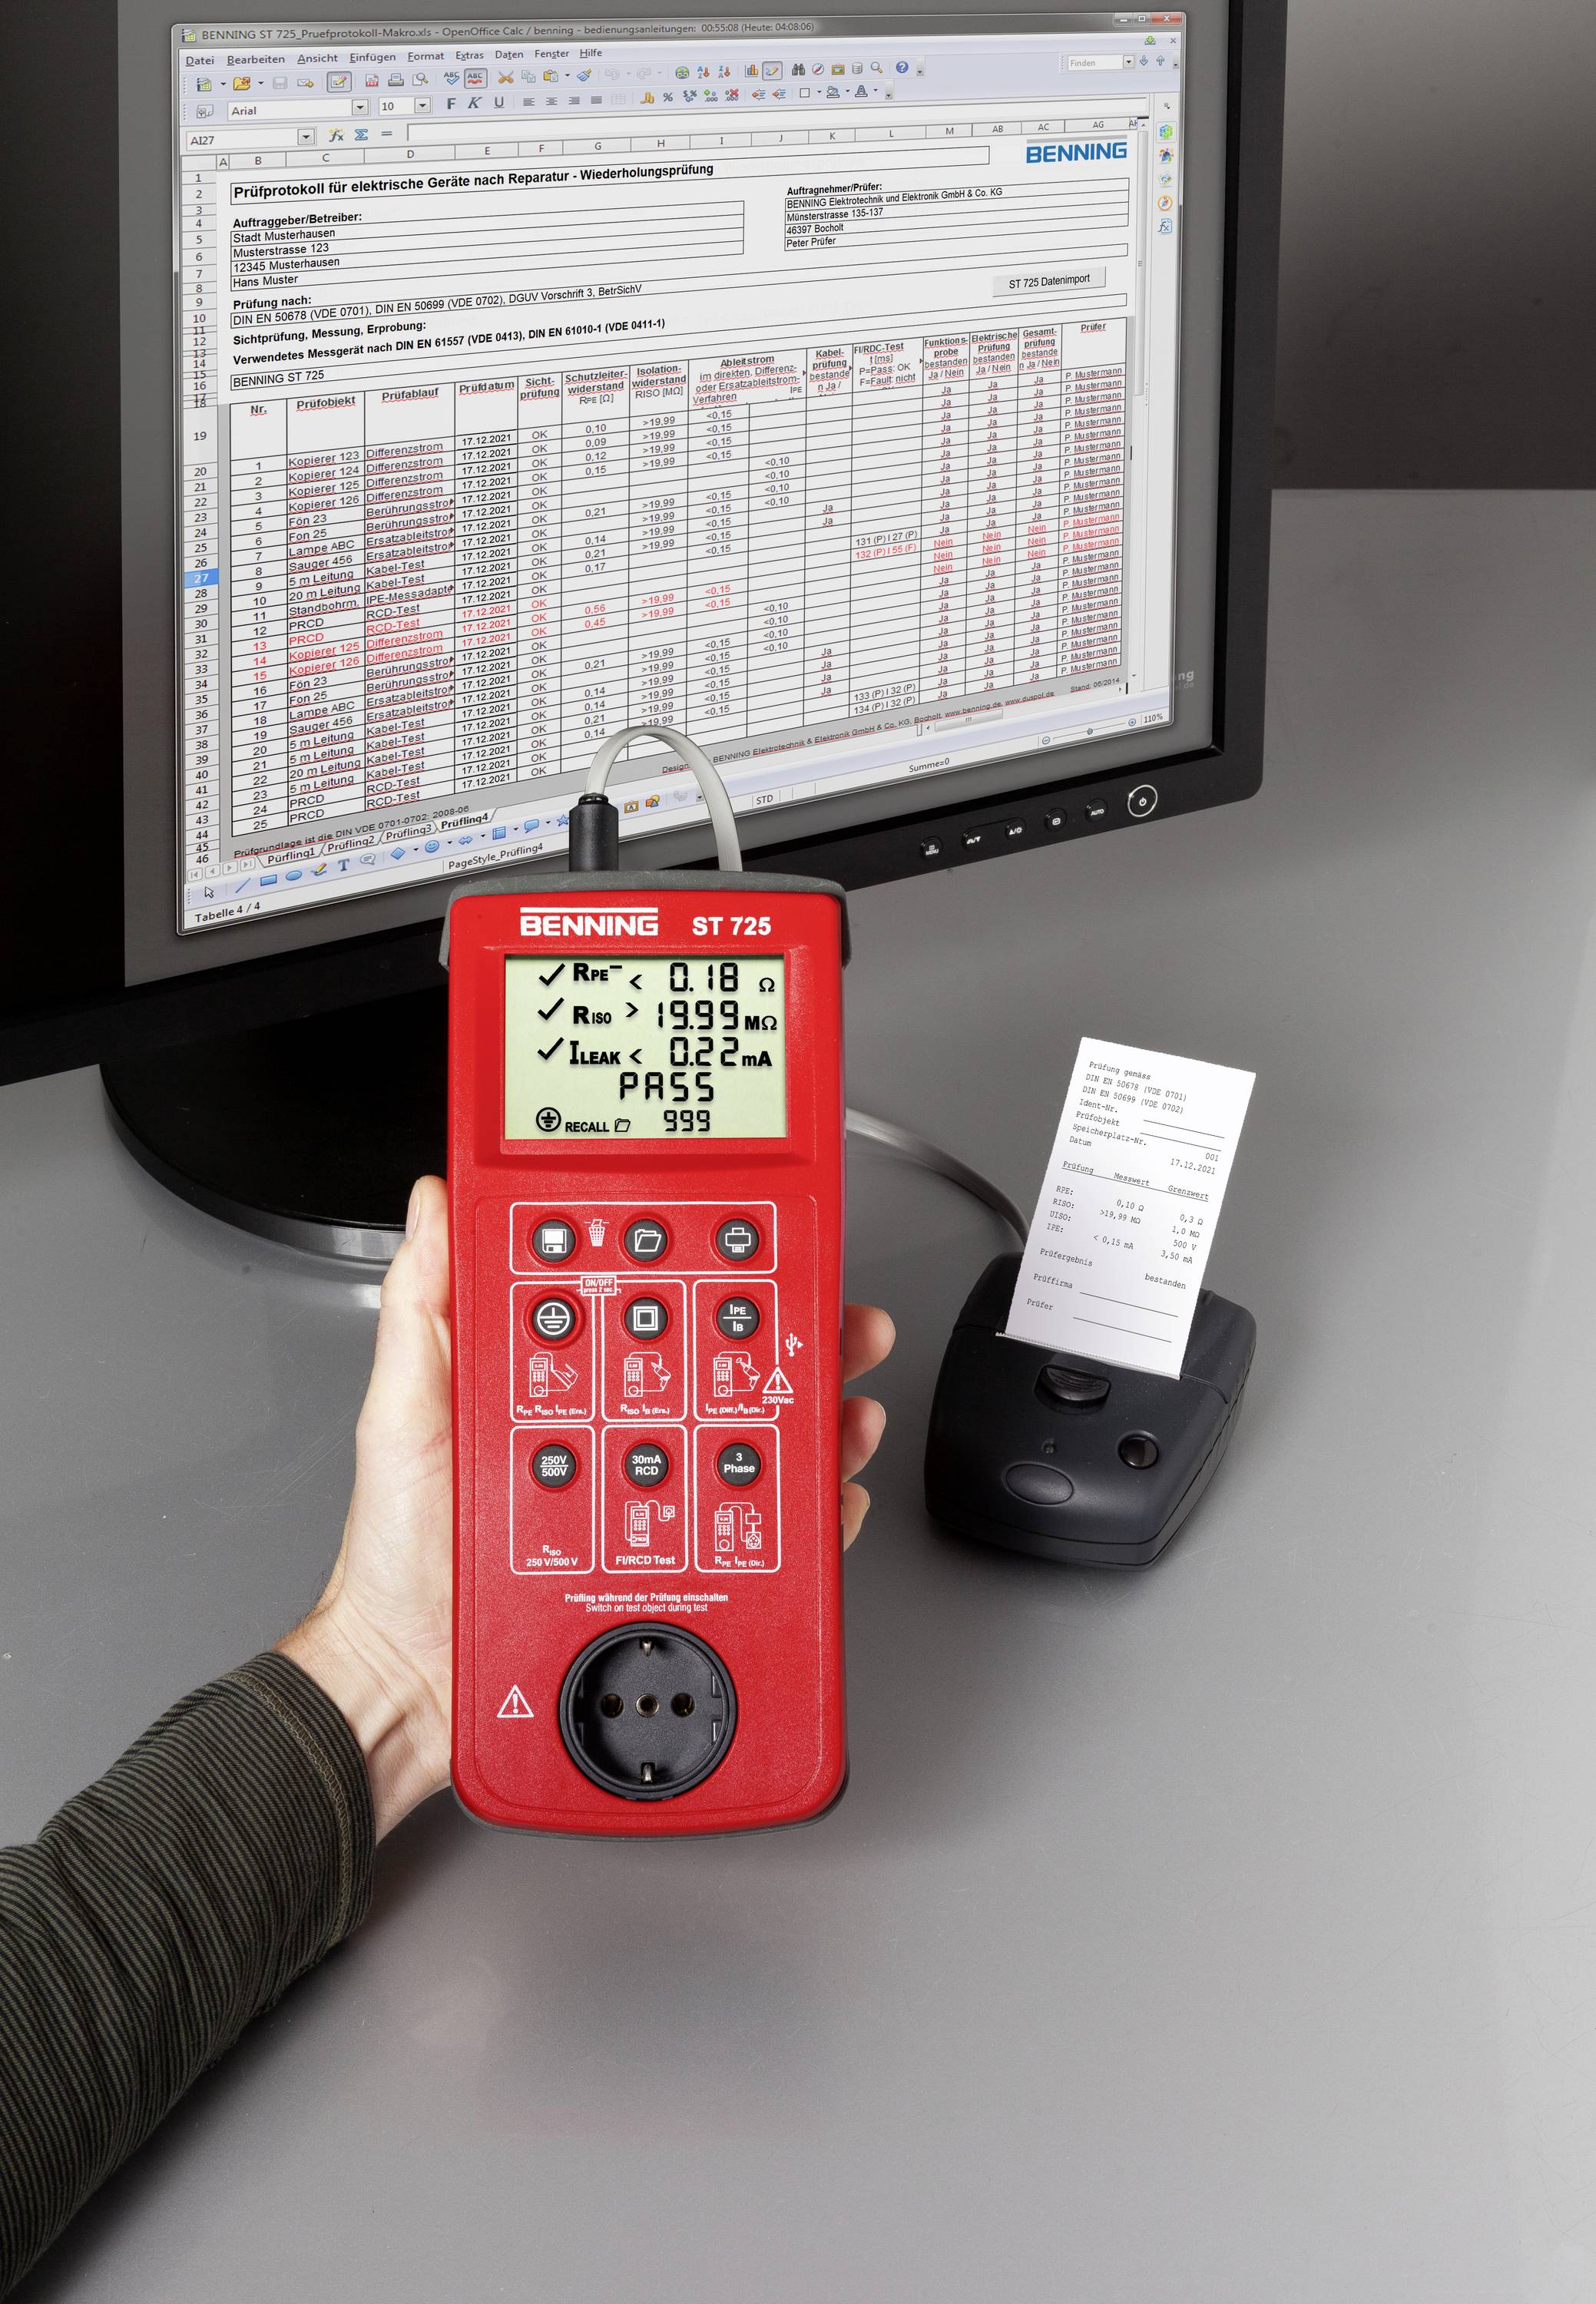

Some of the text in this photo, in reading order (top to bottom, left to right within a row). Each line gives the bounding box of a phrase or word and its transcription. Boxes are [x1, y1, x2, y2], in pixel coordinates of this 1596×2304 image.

[202, 31, 256, 39] BENNING
[442, 27, 499, 37] OpenOffice
[503, 27, 524, 35] Calc
[534, 26, 574, 36] benning
[584, 25, 696, 35] bedienungsanleitungen:
[701, 24, 739, 32] 00:55:08
[742, 23, 773, 31] (Heute:
[776, 22, 814, 31] 04:08:06)
[186, 48, 602, 67] Datei Bearbeiten Ansicht Einfügen Format Extras Daten Fenster Hilfe
[232, 106, 257, 115] Arial
[190, 136, 214, 145] AI27
[1026, 142, 1127, 163] BENNING
[234, 163, 714, 199] Prüfprotokoll für elektrische Geräte nach Reparatur Wiederholungsprüfung
[787, 184, 882, 196] Auftragnehmer/Prüfer:
[233, 213, 363, 229] Auftraggeber/Betreiber:
[787, 207, 883, 221] Münsterstrasse 135-137
[233, 229, 335, 243] Stadt Musterhausen
[787, 223, 843, 234] 46397 Bocholt
[786, 237, 836, 247] Peter Prüfer
[233, 275, 298, 287] Hans Muster
[1009, 274, 1090, 289] ST 725 Datenimport
[233, 296, 311, 310] Prüfung nach:
[233, 322, 425, 345] Sichtprüfung, Messung, Erprobung:
[233, 371, 324, 387] BENNING ST 725
[250, 381, 515, 414] Nr. Prüfobjekt Prüfablauf Prüfdatum
[289, 434, 512, 467] Kopierer 123 Differenzstrom 17.12.2021
[289, 555, 425, 574] Sauger 456 Kabel-Test
[1144, 713, 1164, 723] 110%
[909, 758, 950, 773] Summe=0
[756, 794, 773, 804] STD
[441, 813, 488, 829] Prüfling4
[449, 844, 543, 870] PageStyle_Prüfling4
[195, 906, 234, 922] Tabelle
[520, 915, 771, 935] BENNING ST 725
[670, 962, 738, 991] 0.18
[759, 978, 775, 992] Ω
[658, 1000, 739, 1030] 19.99
[744, 1016, 777, 1031] MΩ
[671, 1037, 738, 1067] 0.22
[742, 1051, 772, 1067] mA
[1089, 1061, 1151, 1080] Prüfung gemäss
[620, 1072, 714, 1101] PASS
[1086, 1074, 1099, 1082] DIN
[1117, 1081, 1139, 1091] 50678
[1144, 1086, 1161, 1097] (VDE
[1166, 1091, 1187, 1101] 0701)
[1079, 1099, 1118, 1113] Ident-Nr.
[1083, 1086, 1096, 1094] DIN
[1113, 1093, 1136, 1103] 50699
[1141, 1098, 1158, 1108] (VDE
[1162, 1103, 1184, 1114] 0702)
[565, 1110, 710, 1132] RECALL 999
[1076, 1111, 1120, 1127] Prüfobjekt
[1073, 1124, 1219, 1162] Speicherplatz-Nr. 001
[1069, 1136, 1215, 1175] Datum 17.12.2021
[1063, 1161, 1209, 1200] Prüfung Messwert Grenzwert
[1056, 1186, 1194, 1224] RPE: 0,10 0,3
[1053, 1198, 1074, 1209] RISO:
[1172, 1226, 1187, 1236] 1,0
[1050, 1211, 1187, 1249] UISO: 500
[1046, 1223, 1064, 1233] IPE:
[1102, 1236, 1121, 1246] 0,15
[1124, 1241, 1134, 1250] mA
[1161, 1250, 1179, 1261] 3,50
[1040, 1248, 1186, 1289] Prüfergebnis bestanden
[585, 1278, 613, 1286] ON/OFF
[1034, 1273, 1073, 1289] Prüffirma
[1027, 1299, 1053, 1310] Prüfer
[541, 1455, 567, 1465] 250V
[632, 1455, 661, 1465] 30mA
[736, 1453, 743, 1462] 3
[541, 1466, 567, 1477] 500V
[635, 1466, 658, 1475] RCD
[724, 1464, 755, 1473] Phase
[616, 1555, 675, 1565] FI/RCD Test
[565, 1593, 728, 1603] Prüfling während der Prüfung einschalten
[586, 1603, 611, 1612] Switch
[626, 1604, 640, 1612] test
[642, 1603, 666, 1613] object
[668, 1603, 691, 1613] during
[694, 1603, 707, 1611] test
